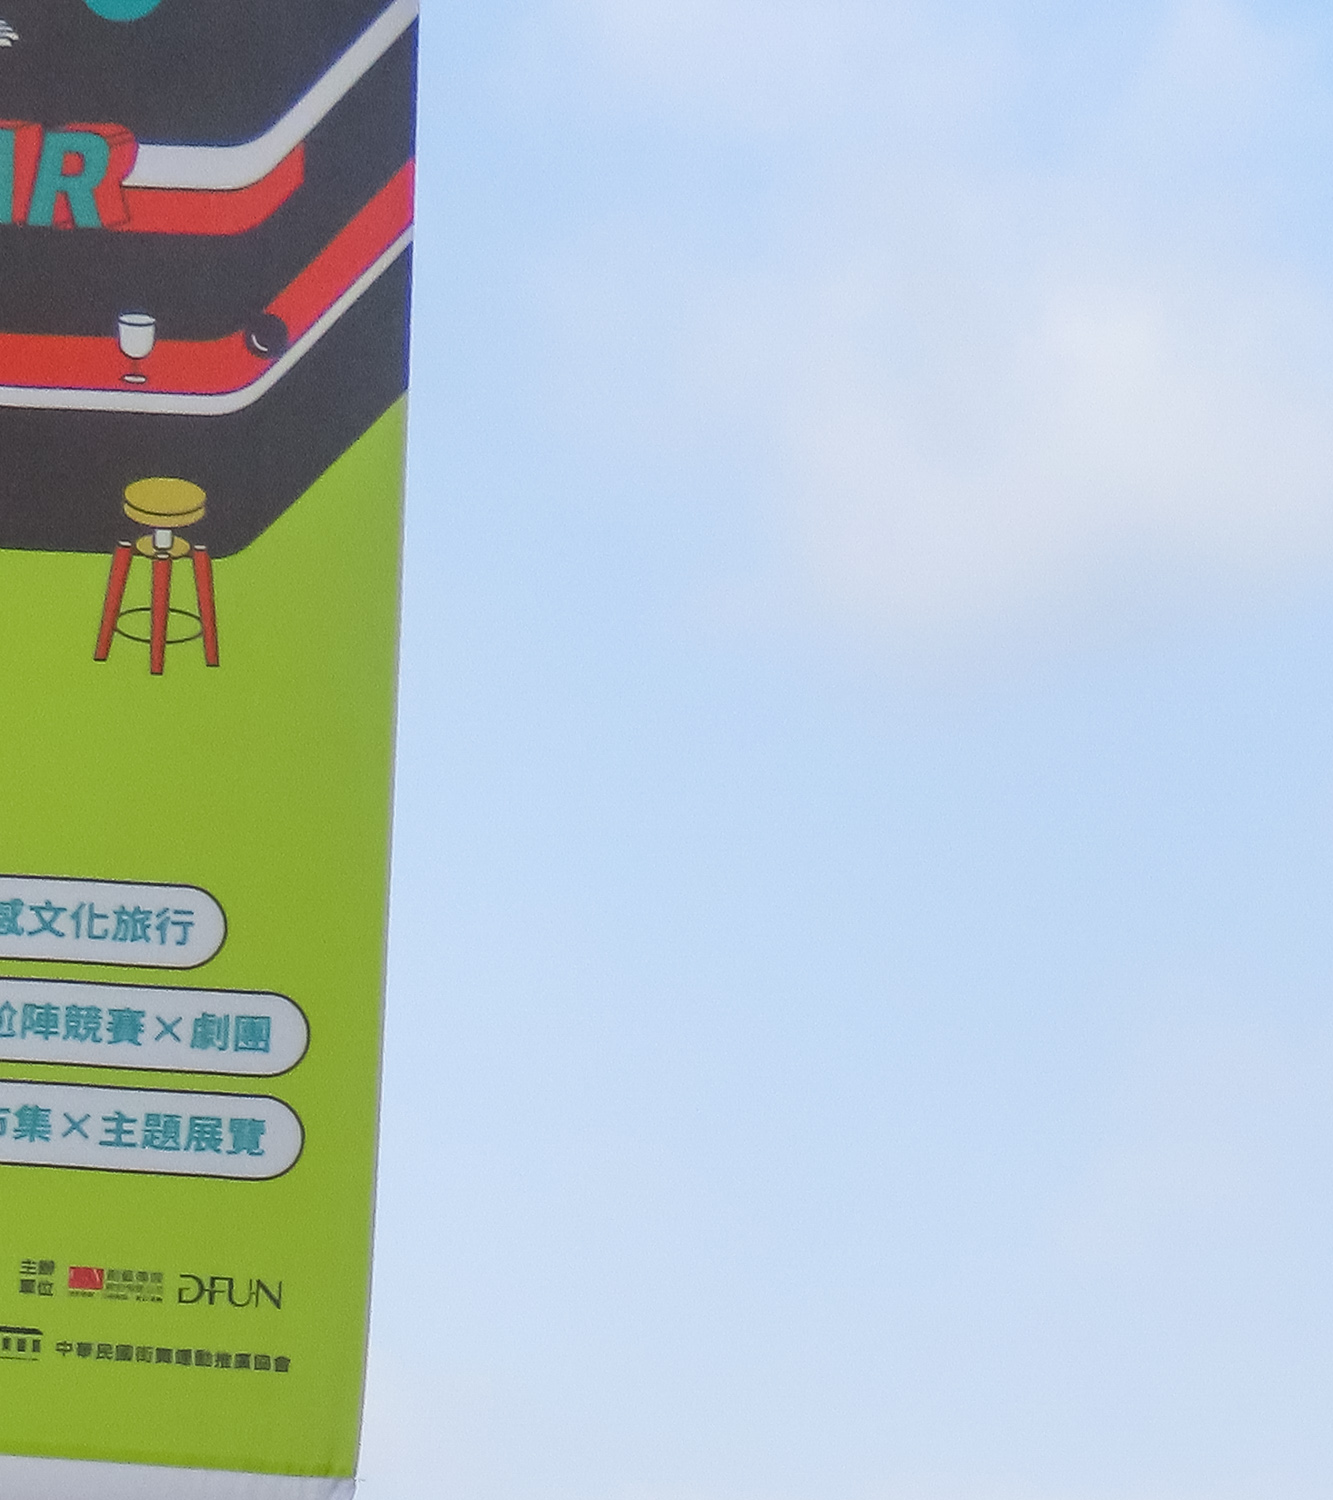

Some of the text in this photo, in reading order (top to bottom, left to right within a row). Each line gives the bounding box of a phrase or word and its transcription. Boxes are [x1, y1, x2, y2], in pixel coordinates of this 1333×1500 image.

[0, 1104, 266, 1156] 集×主題展覽
